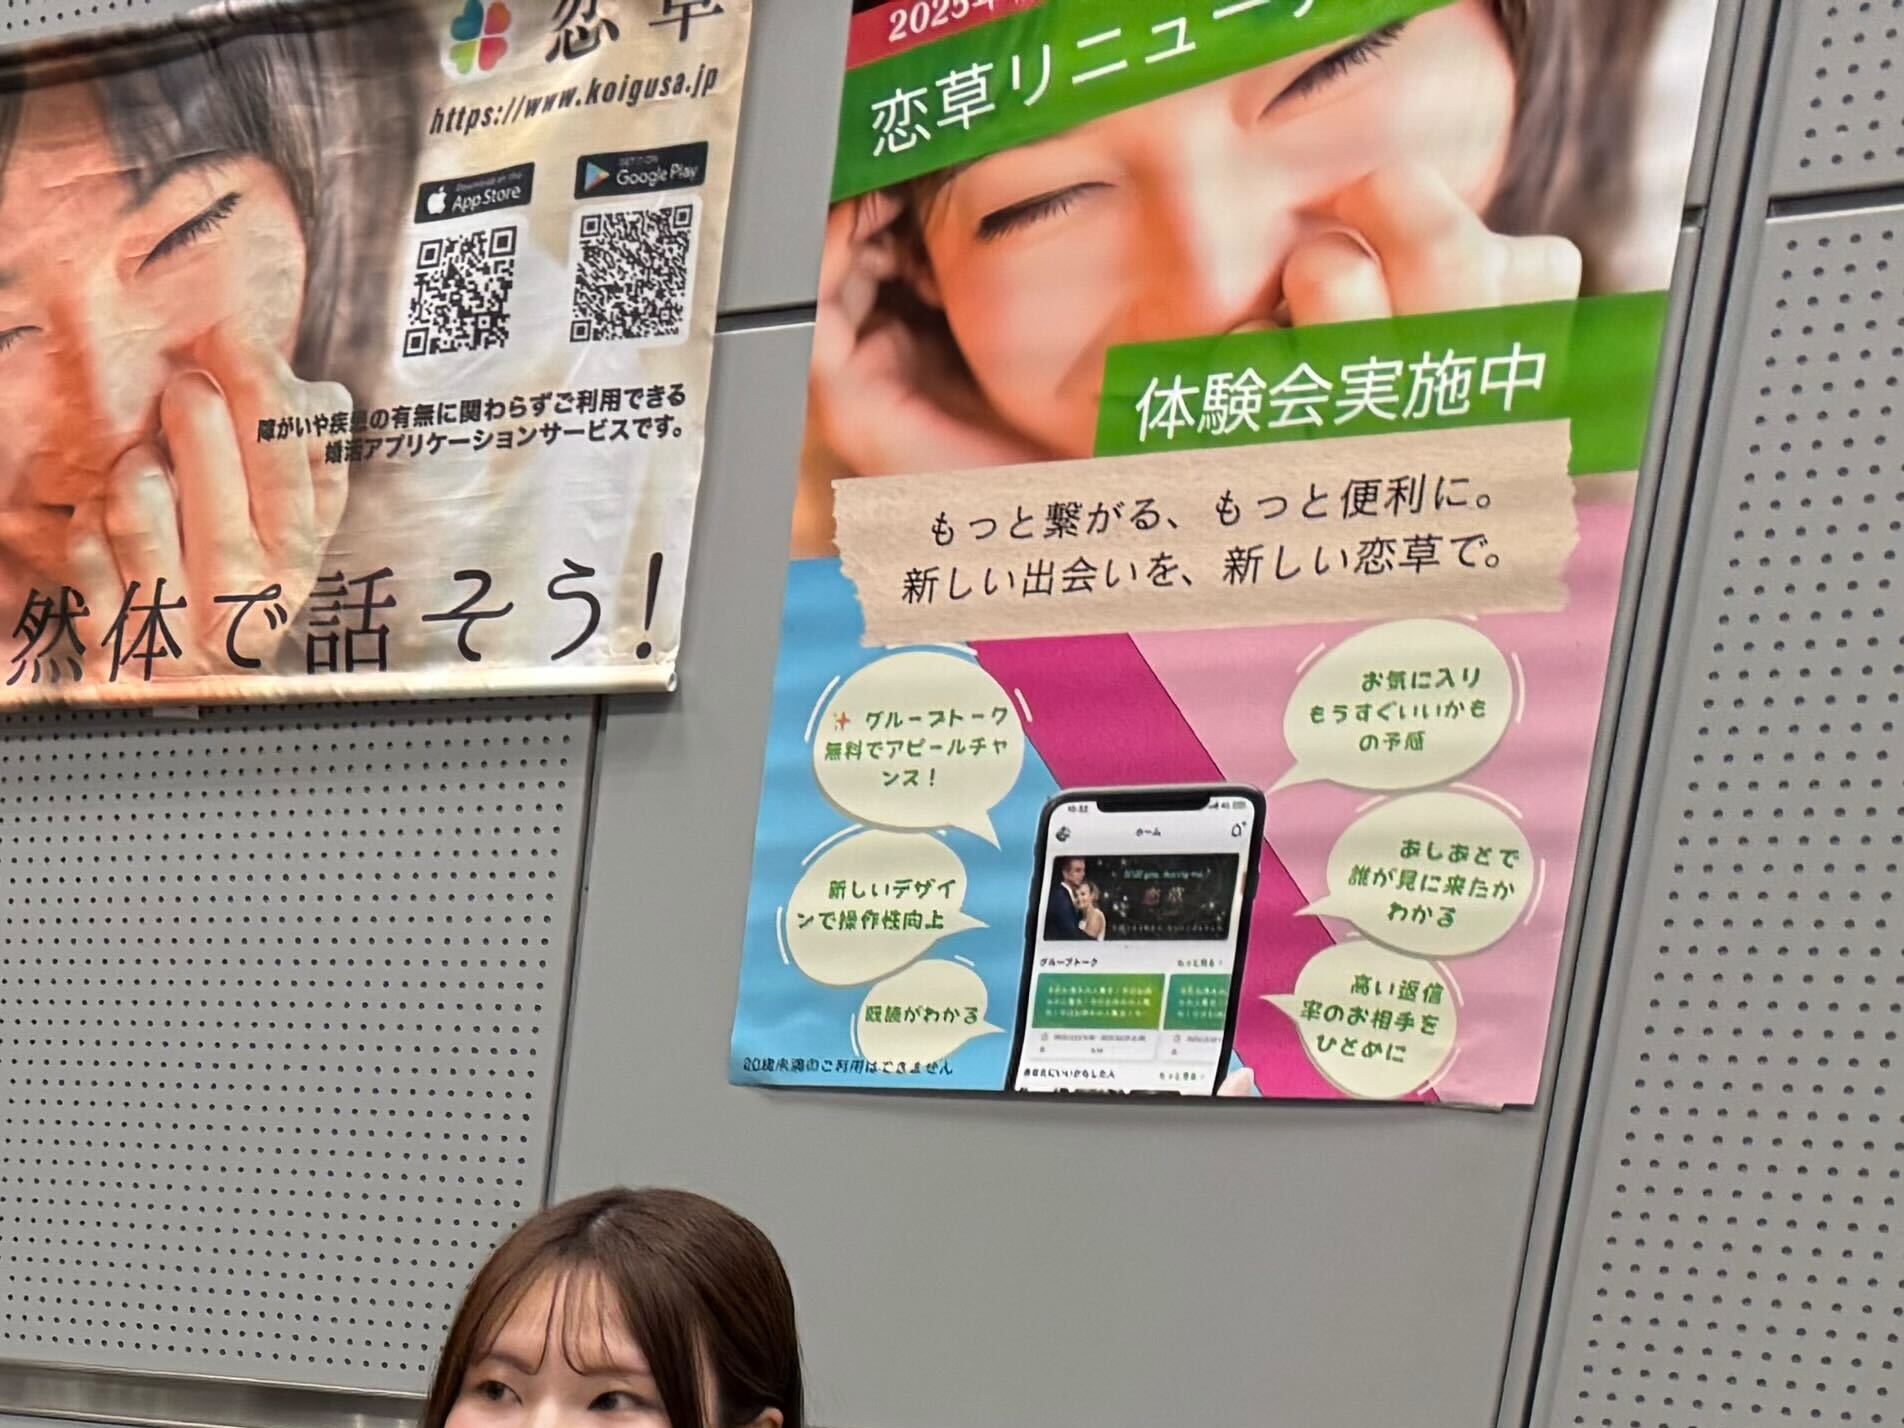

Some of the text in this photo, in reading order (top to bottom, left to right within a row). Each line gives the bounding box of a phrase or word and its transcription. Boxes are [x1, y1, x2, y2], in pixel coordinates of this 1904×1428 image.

[871, 0, 1316, 158] 恋草リニュー
[429, 63, 719, 136] https://www.koigusa.jp
[616, 164, 699, 188] Google Play
[451, 183, 521, 213] App Store
[1134, 342, 1546, 443] 体験会実施中
[257, 383, 687, 443] 障がいや疾患の有無に関わらずご利用できる
[324, 415, 683, 464] 婚活アプリケーションサービスです。
[1360, 666, 1481, 693] お気に入り
[865, 706, 1008, 730] グループトーク
[1309, 698, 1487, 725] もうすぐいいかも
[824, 738, 1008, 762] 無料でアピールチャ
[1359, 729, 1426, 752] の予感
[882, 767, 936, 788] ンス！
[1399, 838, 1520, 871] あしあとで
[828, 878, 957, 901] 新しいデザイ
[1348, 863, 1515, 902] 誰が見に来たか
[796, 910, 945, 932] ンで操作性向上
[1386, 900, 1457, 929] わかる
[1350, 973, 1444, 1006] 高い返信
[864, 1004, 979, 1026] 既読がわかる
[1299, 998, 1440, 1036] 率のお相手を
[1315, 1032, 1408, 1064] ひとめに
